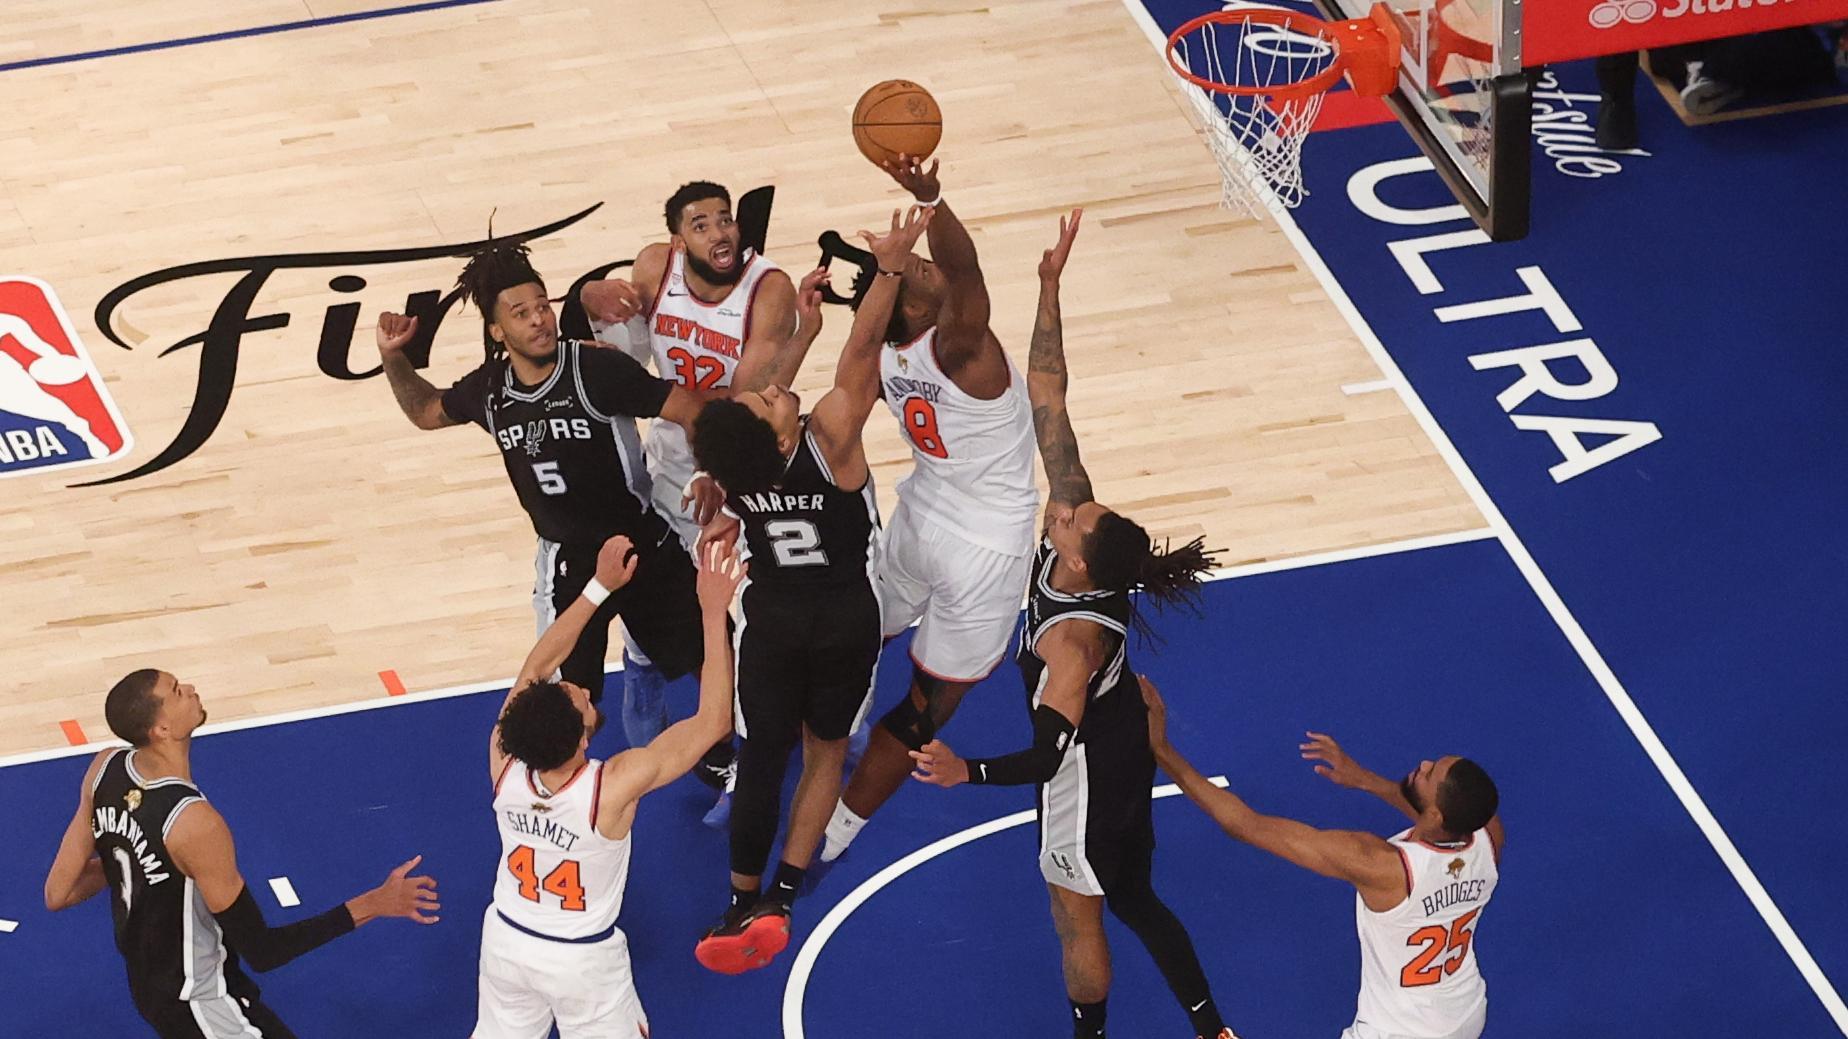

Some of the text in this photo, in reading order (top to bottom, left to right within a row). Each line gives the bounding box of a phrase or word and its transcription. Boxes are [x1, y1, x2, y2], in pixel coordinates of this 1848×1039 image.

[655, 313, 741, 360] NEW YORK
[1347, 155, 1662, 483] ULTRA
[667, 346, 726, 391] 32
[903, 396, 949, 459] 8
[532, 460, 568, 495] 5
[739, 491, 824, 513] HARPER
[764, 519, 830, 567] 2
[91, 806, 170, 886] MBANYAMA
[507, 811, 580, 852] SHAMET
[507, 844, 586, 912] 44
[1422, 880, 1486, 917] BRIDGES
[1400, 905, 1482, 987] 25
